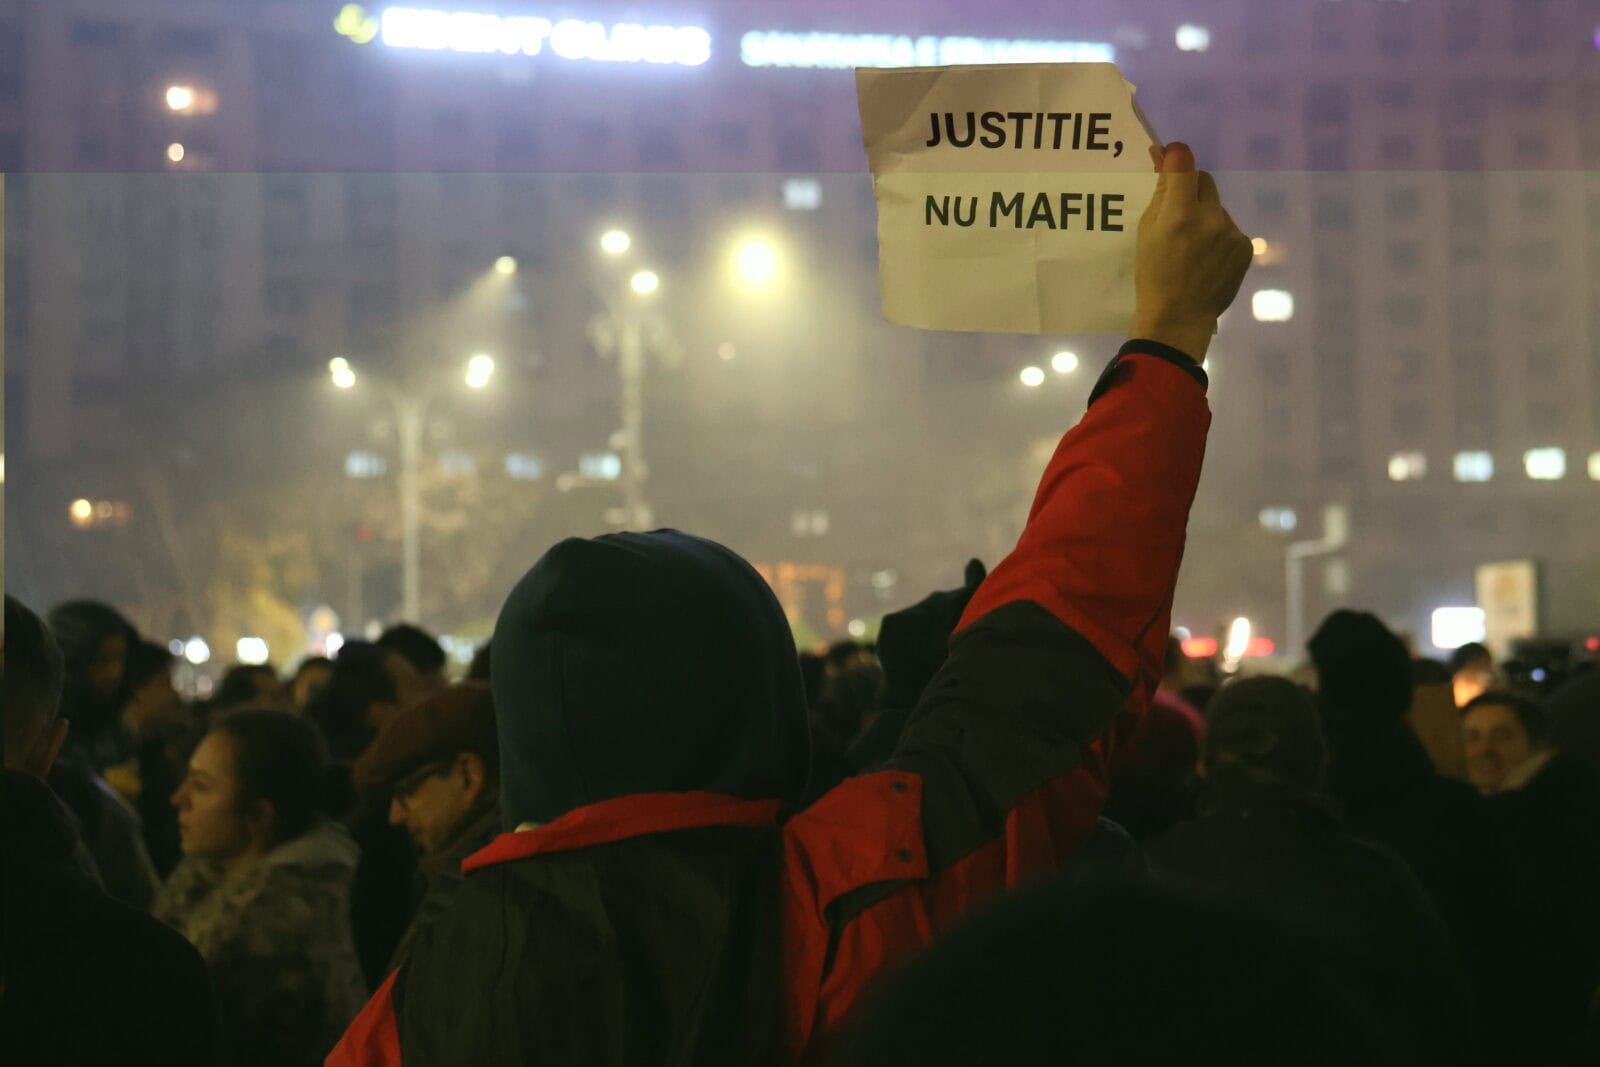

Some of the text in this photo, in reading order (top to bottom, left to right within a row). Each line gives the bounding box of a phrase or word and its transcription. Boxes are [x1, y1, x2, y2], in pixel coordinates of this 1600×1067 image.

[925, 111, 1124, 158] JUSTITIE,
[925, 191, 1125, 232] NU MAFIE
